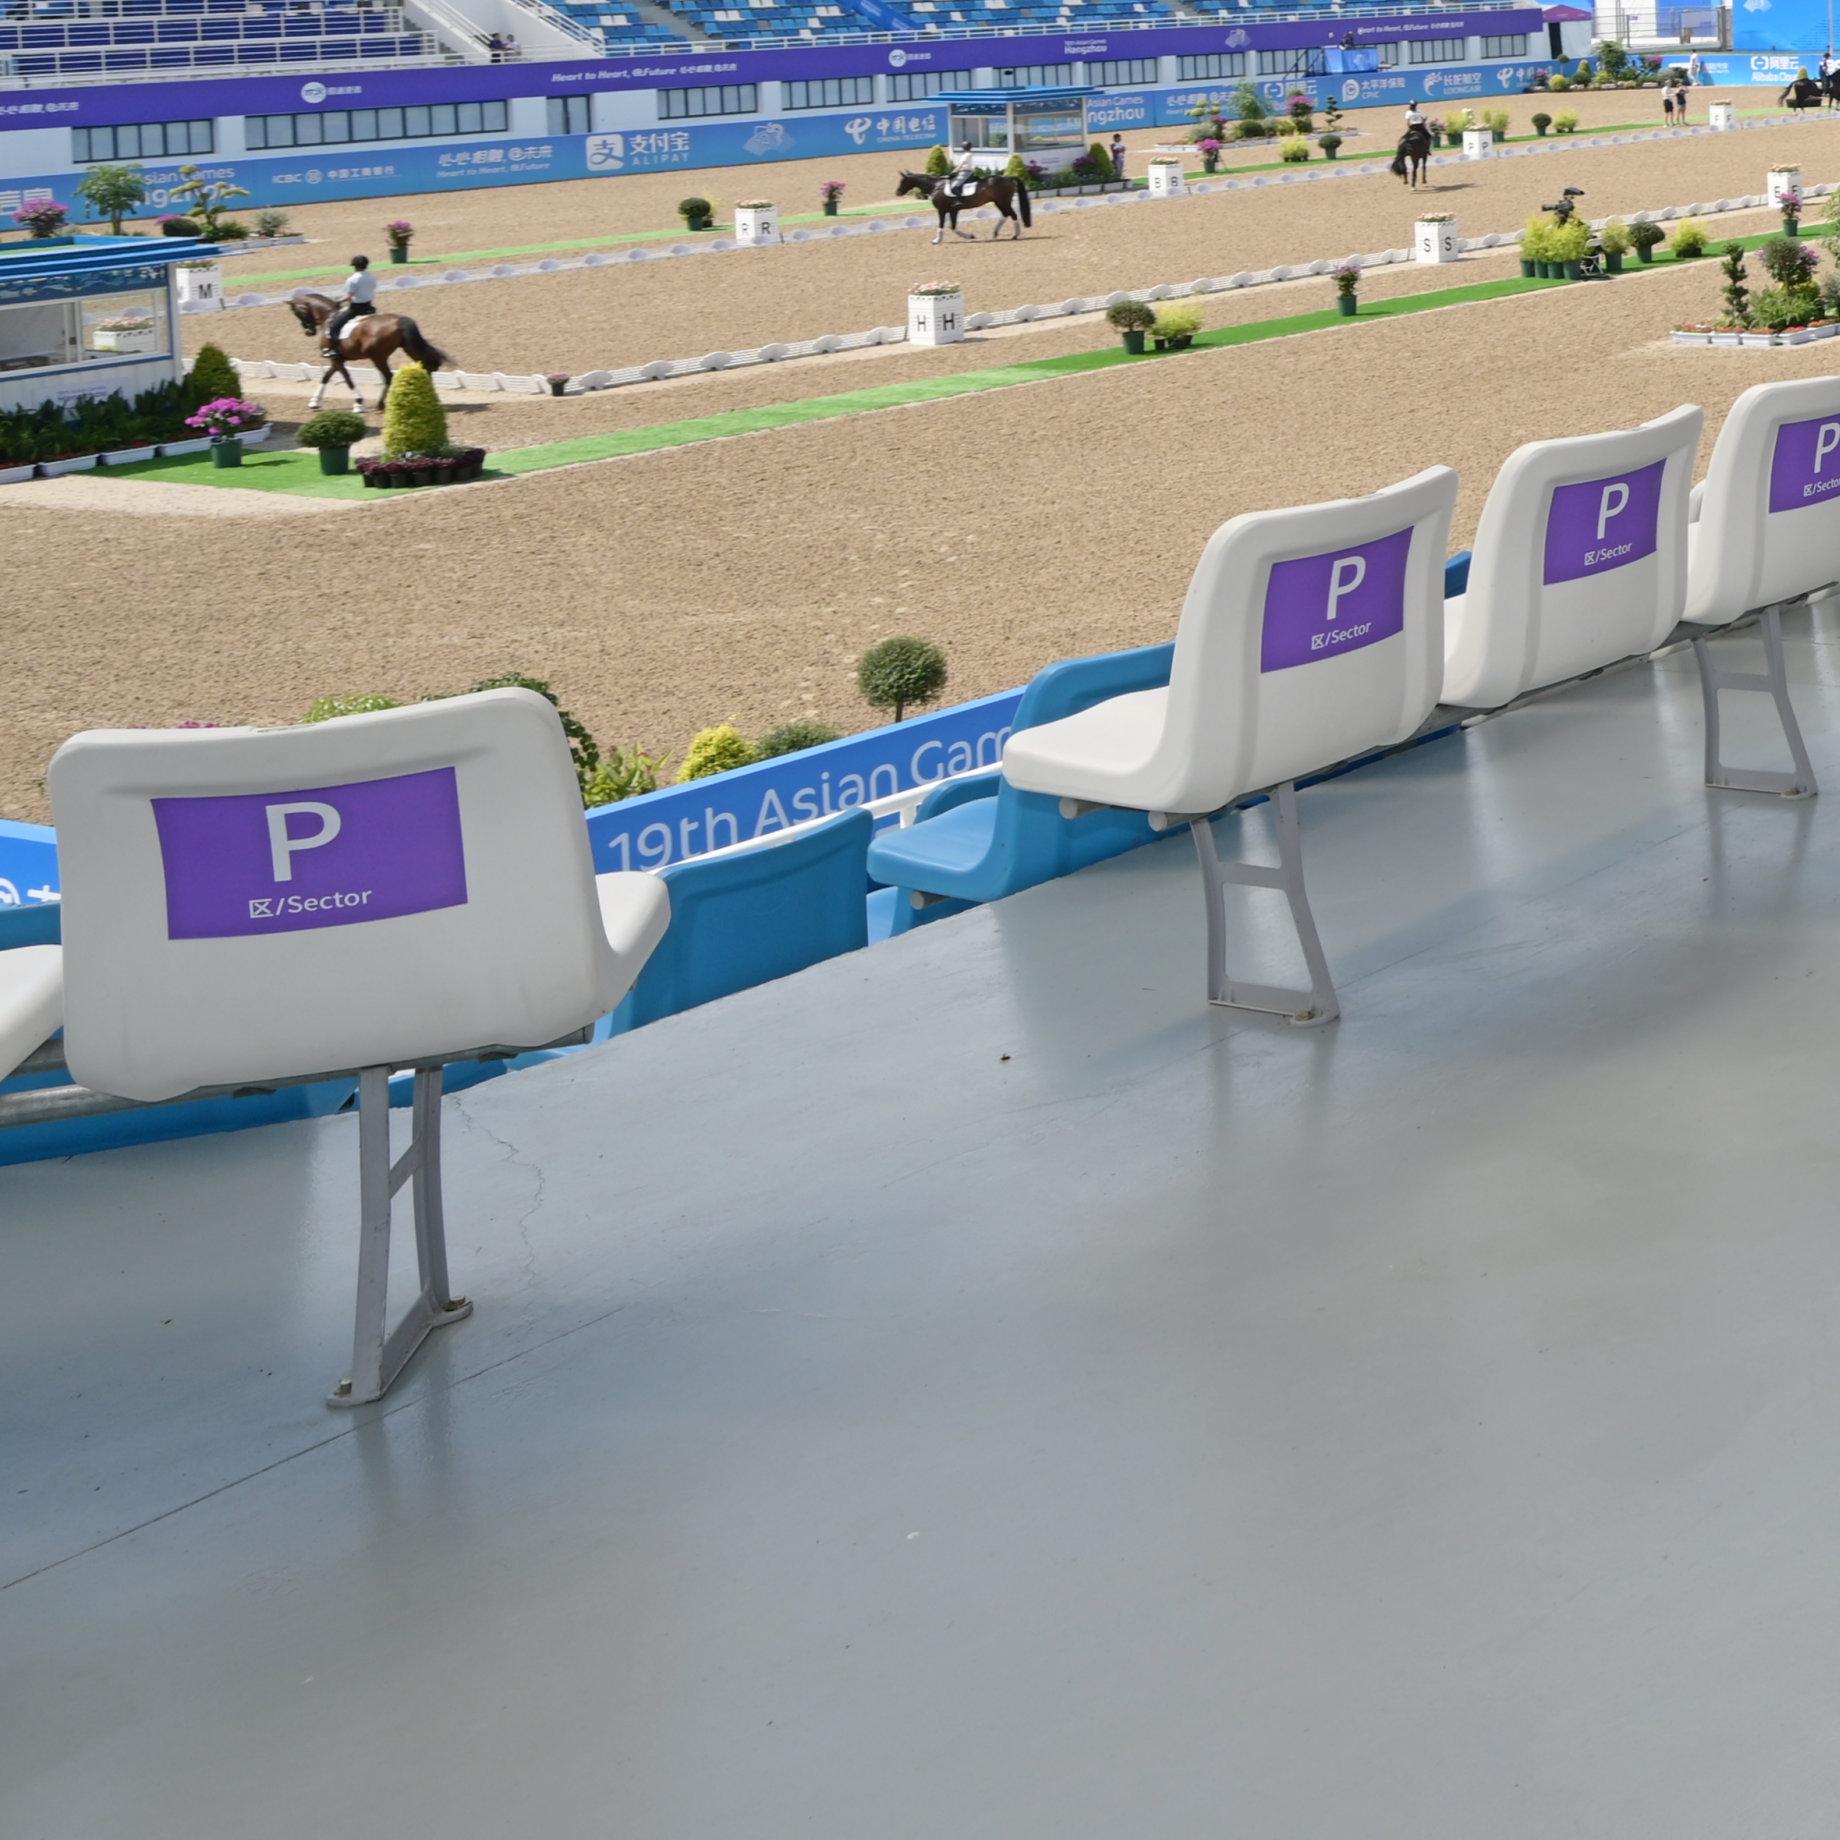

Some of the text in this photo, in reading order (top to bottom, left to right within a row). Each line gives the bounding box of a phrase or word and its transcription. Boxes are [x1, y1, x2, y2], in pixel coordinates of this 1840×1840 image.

[1769, 56, 1800, 70] 阿里云
[551, 72, 583, 82] Heart
[585, 71, 596, 81] to
[598, 69, 631, 81] Heart,
[632, 66, 677, 78] @Future
[1113, 95, 1144, 107] Games
[876, 114, 937, 134] 中国电信
[629, 131, 690, 156] 支付宝
[632, 151, 690, 166] ALIPAY
[143, 171, 178, 184] sian
[272, 173, 303, 184] ICBC
[760, 221, 771, 235] R
[1423, 237, 1452, 252] S S
[198, 283, 212, 300] M
[916, 312, 955, 332] H H
[1597, 483, 1630, 540] P
[1584, 541, 1633, 566] 区/Sector
[1327, 556, 1367, 621] P
[1311, 620, 1373, 651] 区/Sector
[607, 805, 741, 873] 19th
[753, 762, 899, 838] Asian
[265, 801, 342, 882] P
[248, 887, 373, 919] 区/Sector
